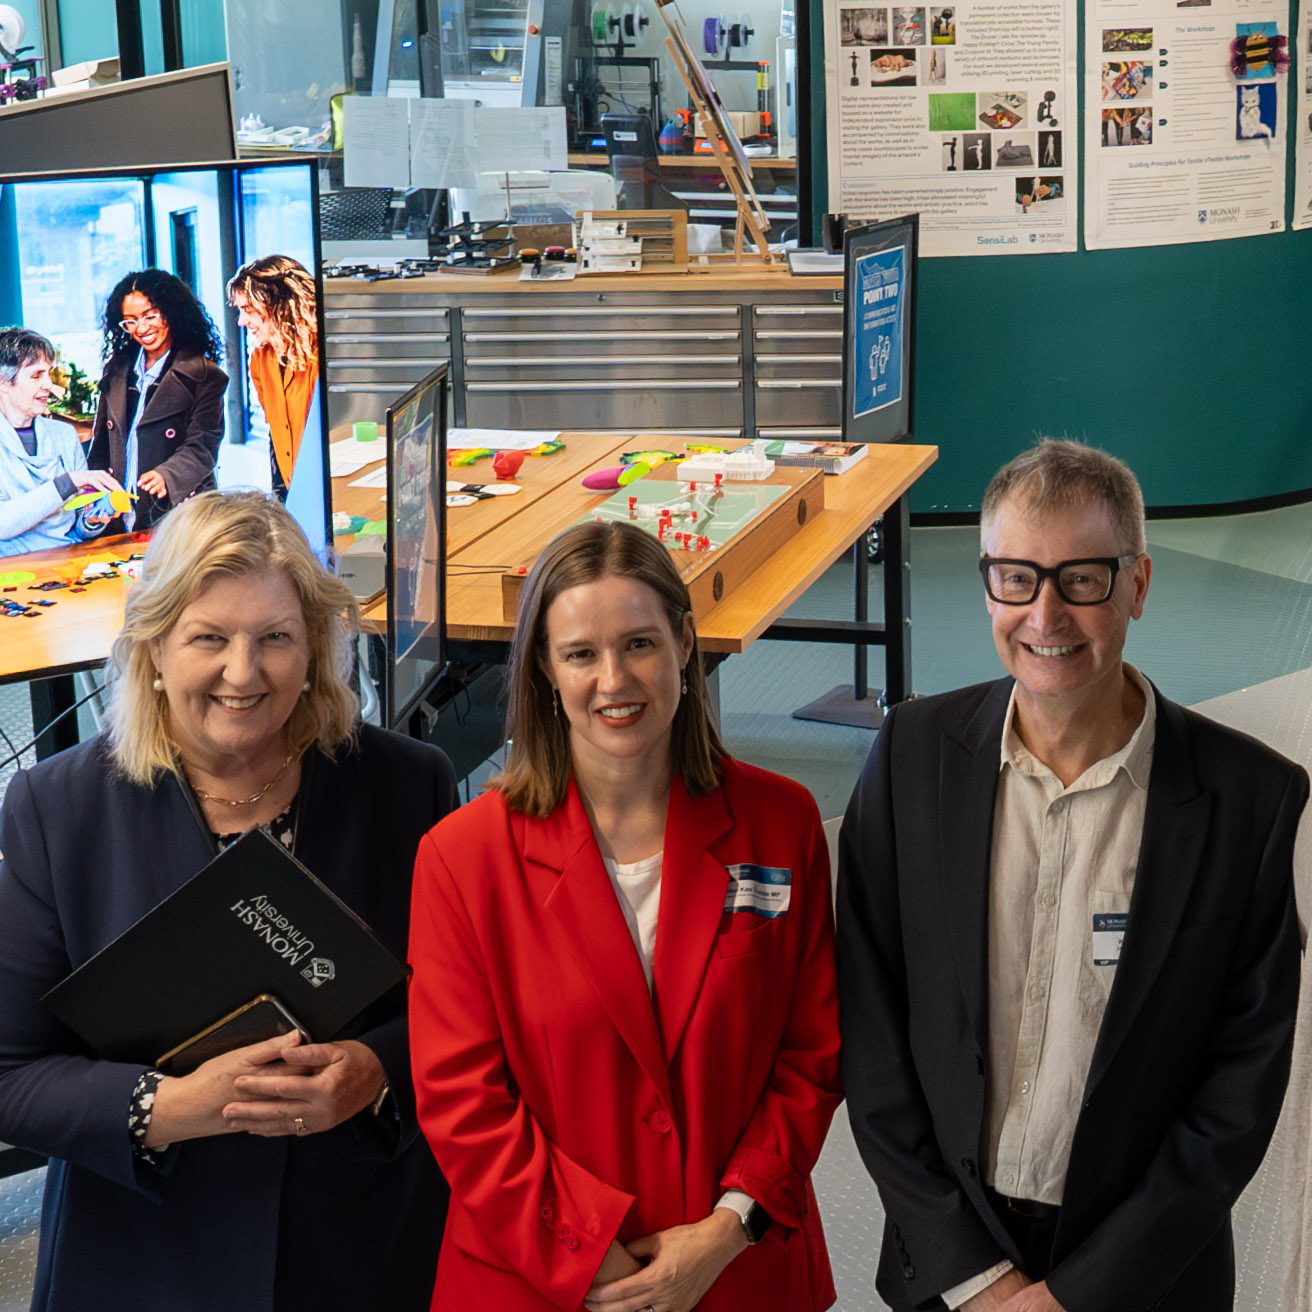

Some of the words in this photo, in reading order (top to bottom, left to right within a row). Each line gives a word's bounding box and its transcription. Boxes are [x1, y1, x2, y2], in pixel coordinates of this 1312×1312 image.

[1210, 207, 1240, 216] MONASH
[977, 235, 1018, 245] SensiLab
[864, 289, 883, 306] POINT
[884, 282, 898, 298] TWO
[230, 900, 304, 966] MONASH
[250, 895, 314, 957] University
